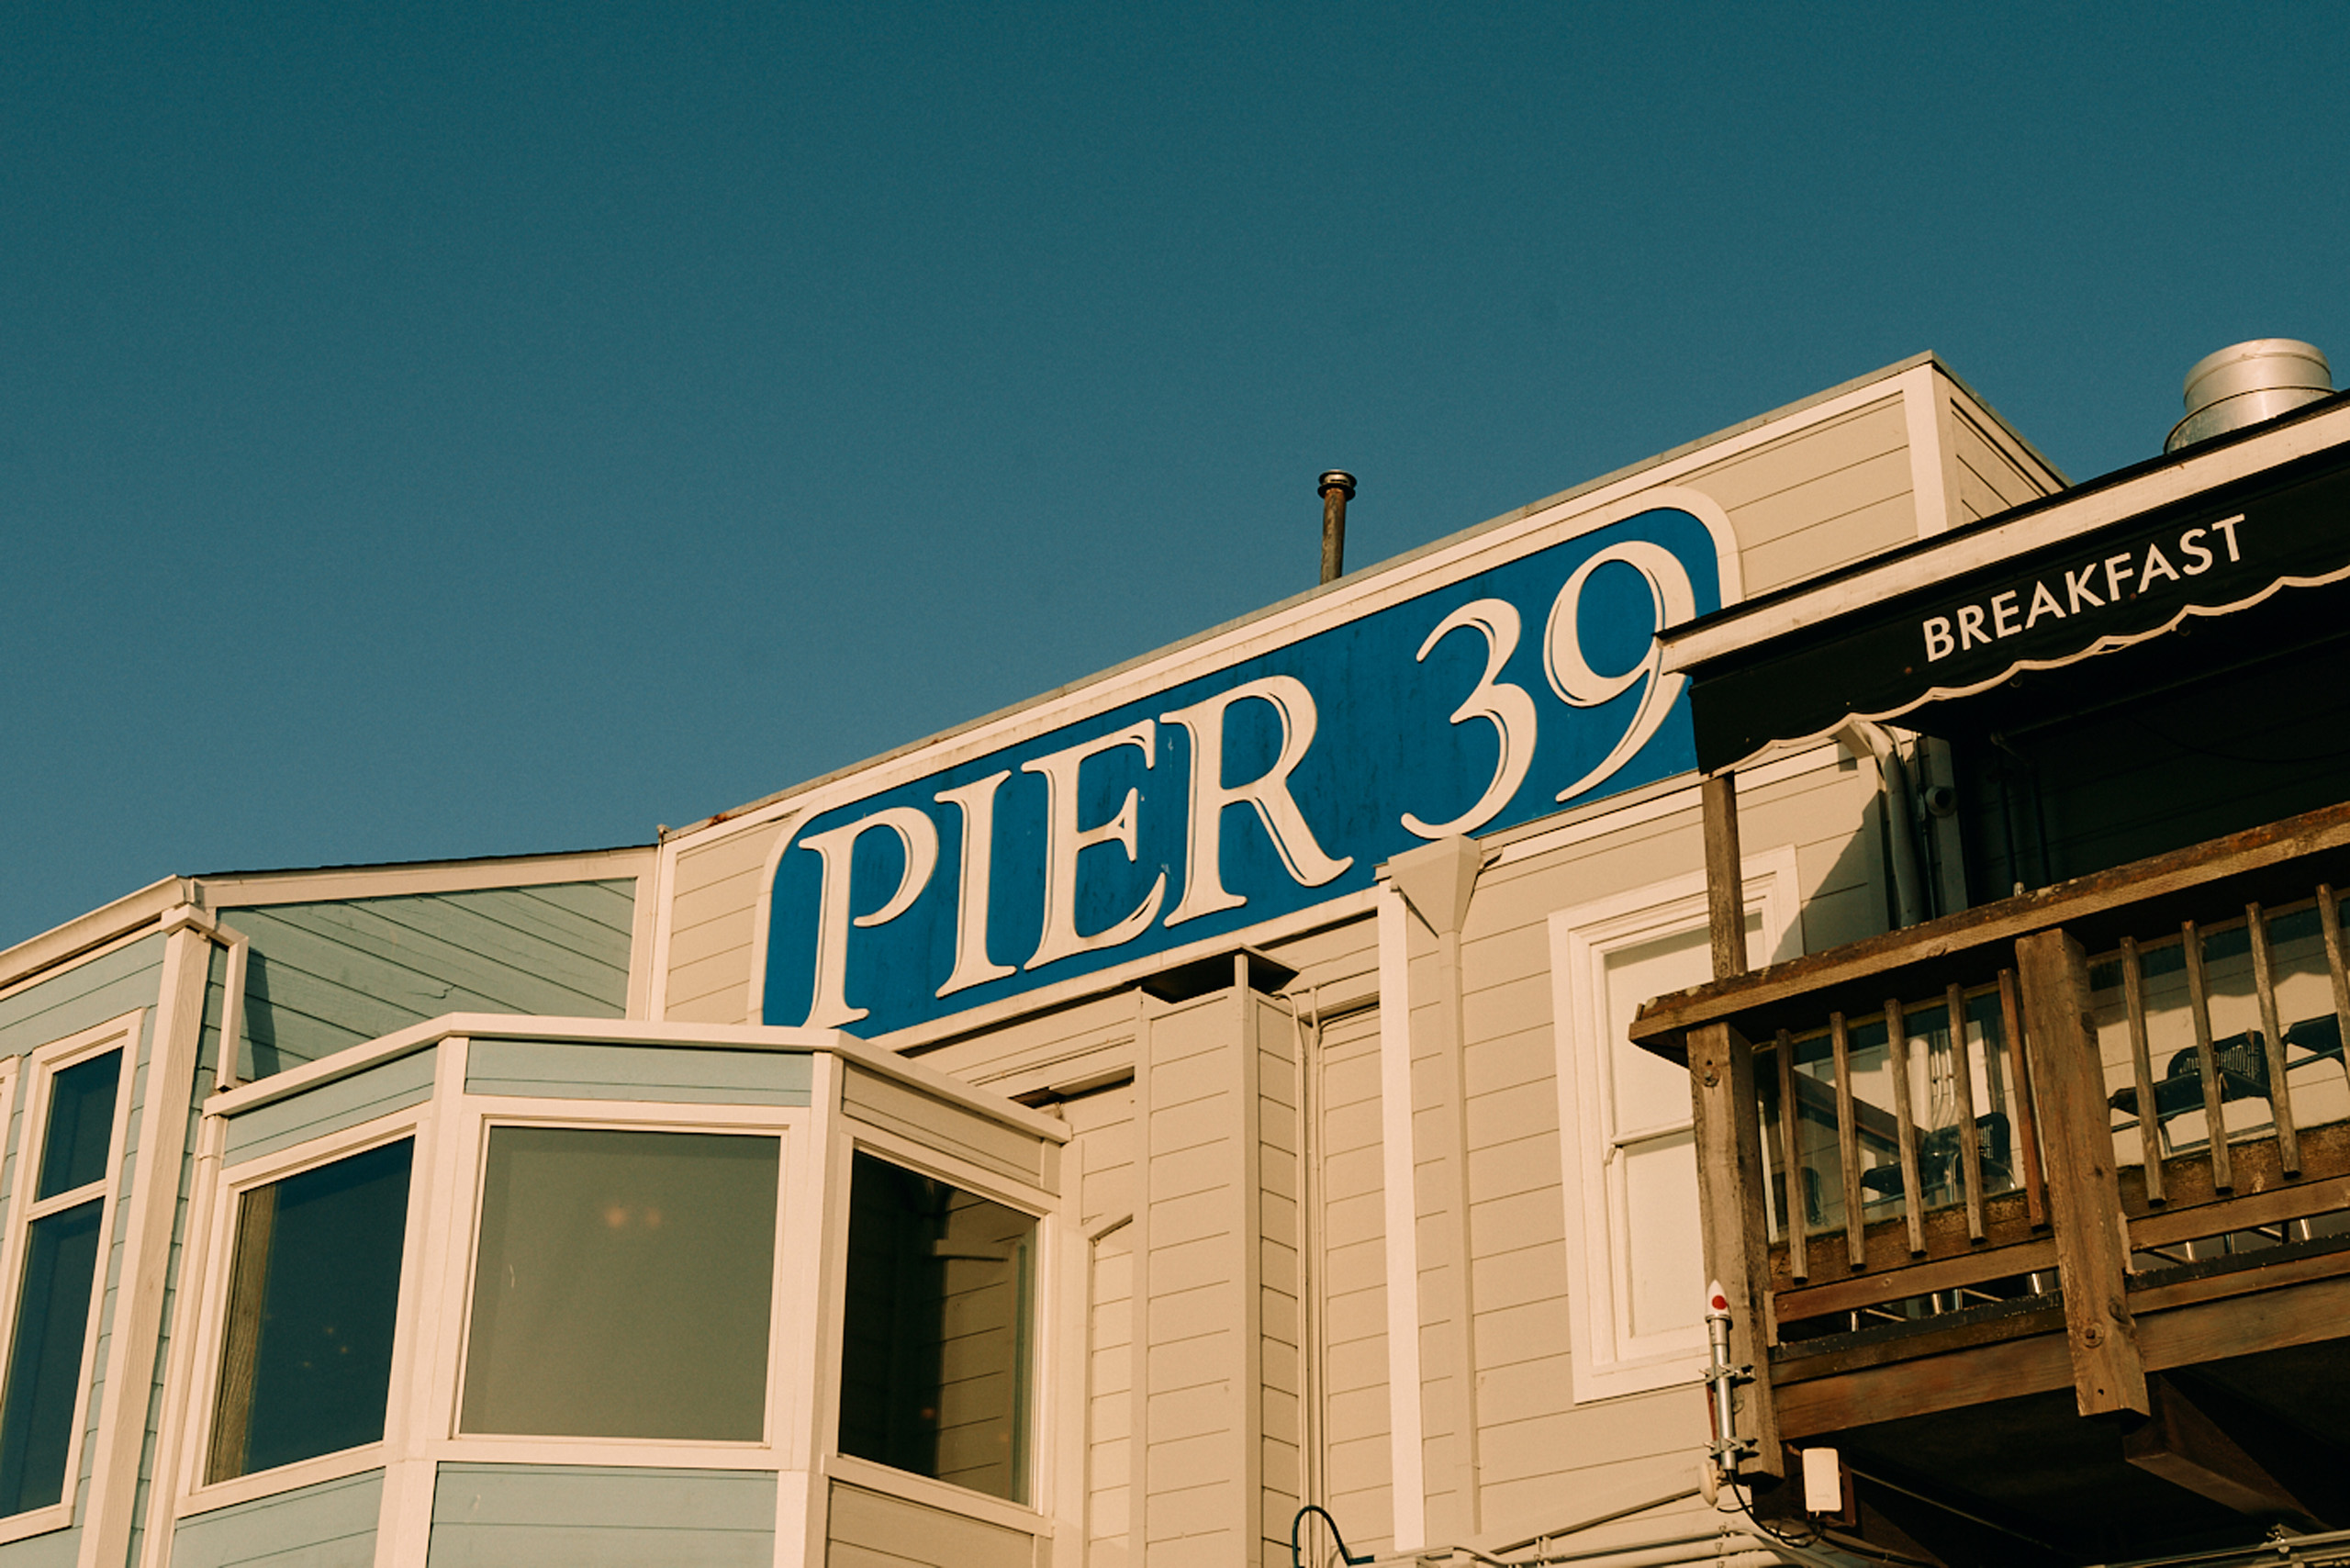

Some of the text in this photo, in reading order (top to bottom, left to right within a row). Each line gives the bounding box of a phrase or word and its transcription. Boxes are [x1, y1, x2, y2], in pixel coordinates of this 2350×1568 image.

[1922, 513, 2245, 662] BREAKFAST
[799, 541, 1695, 1029] PIER 39
